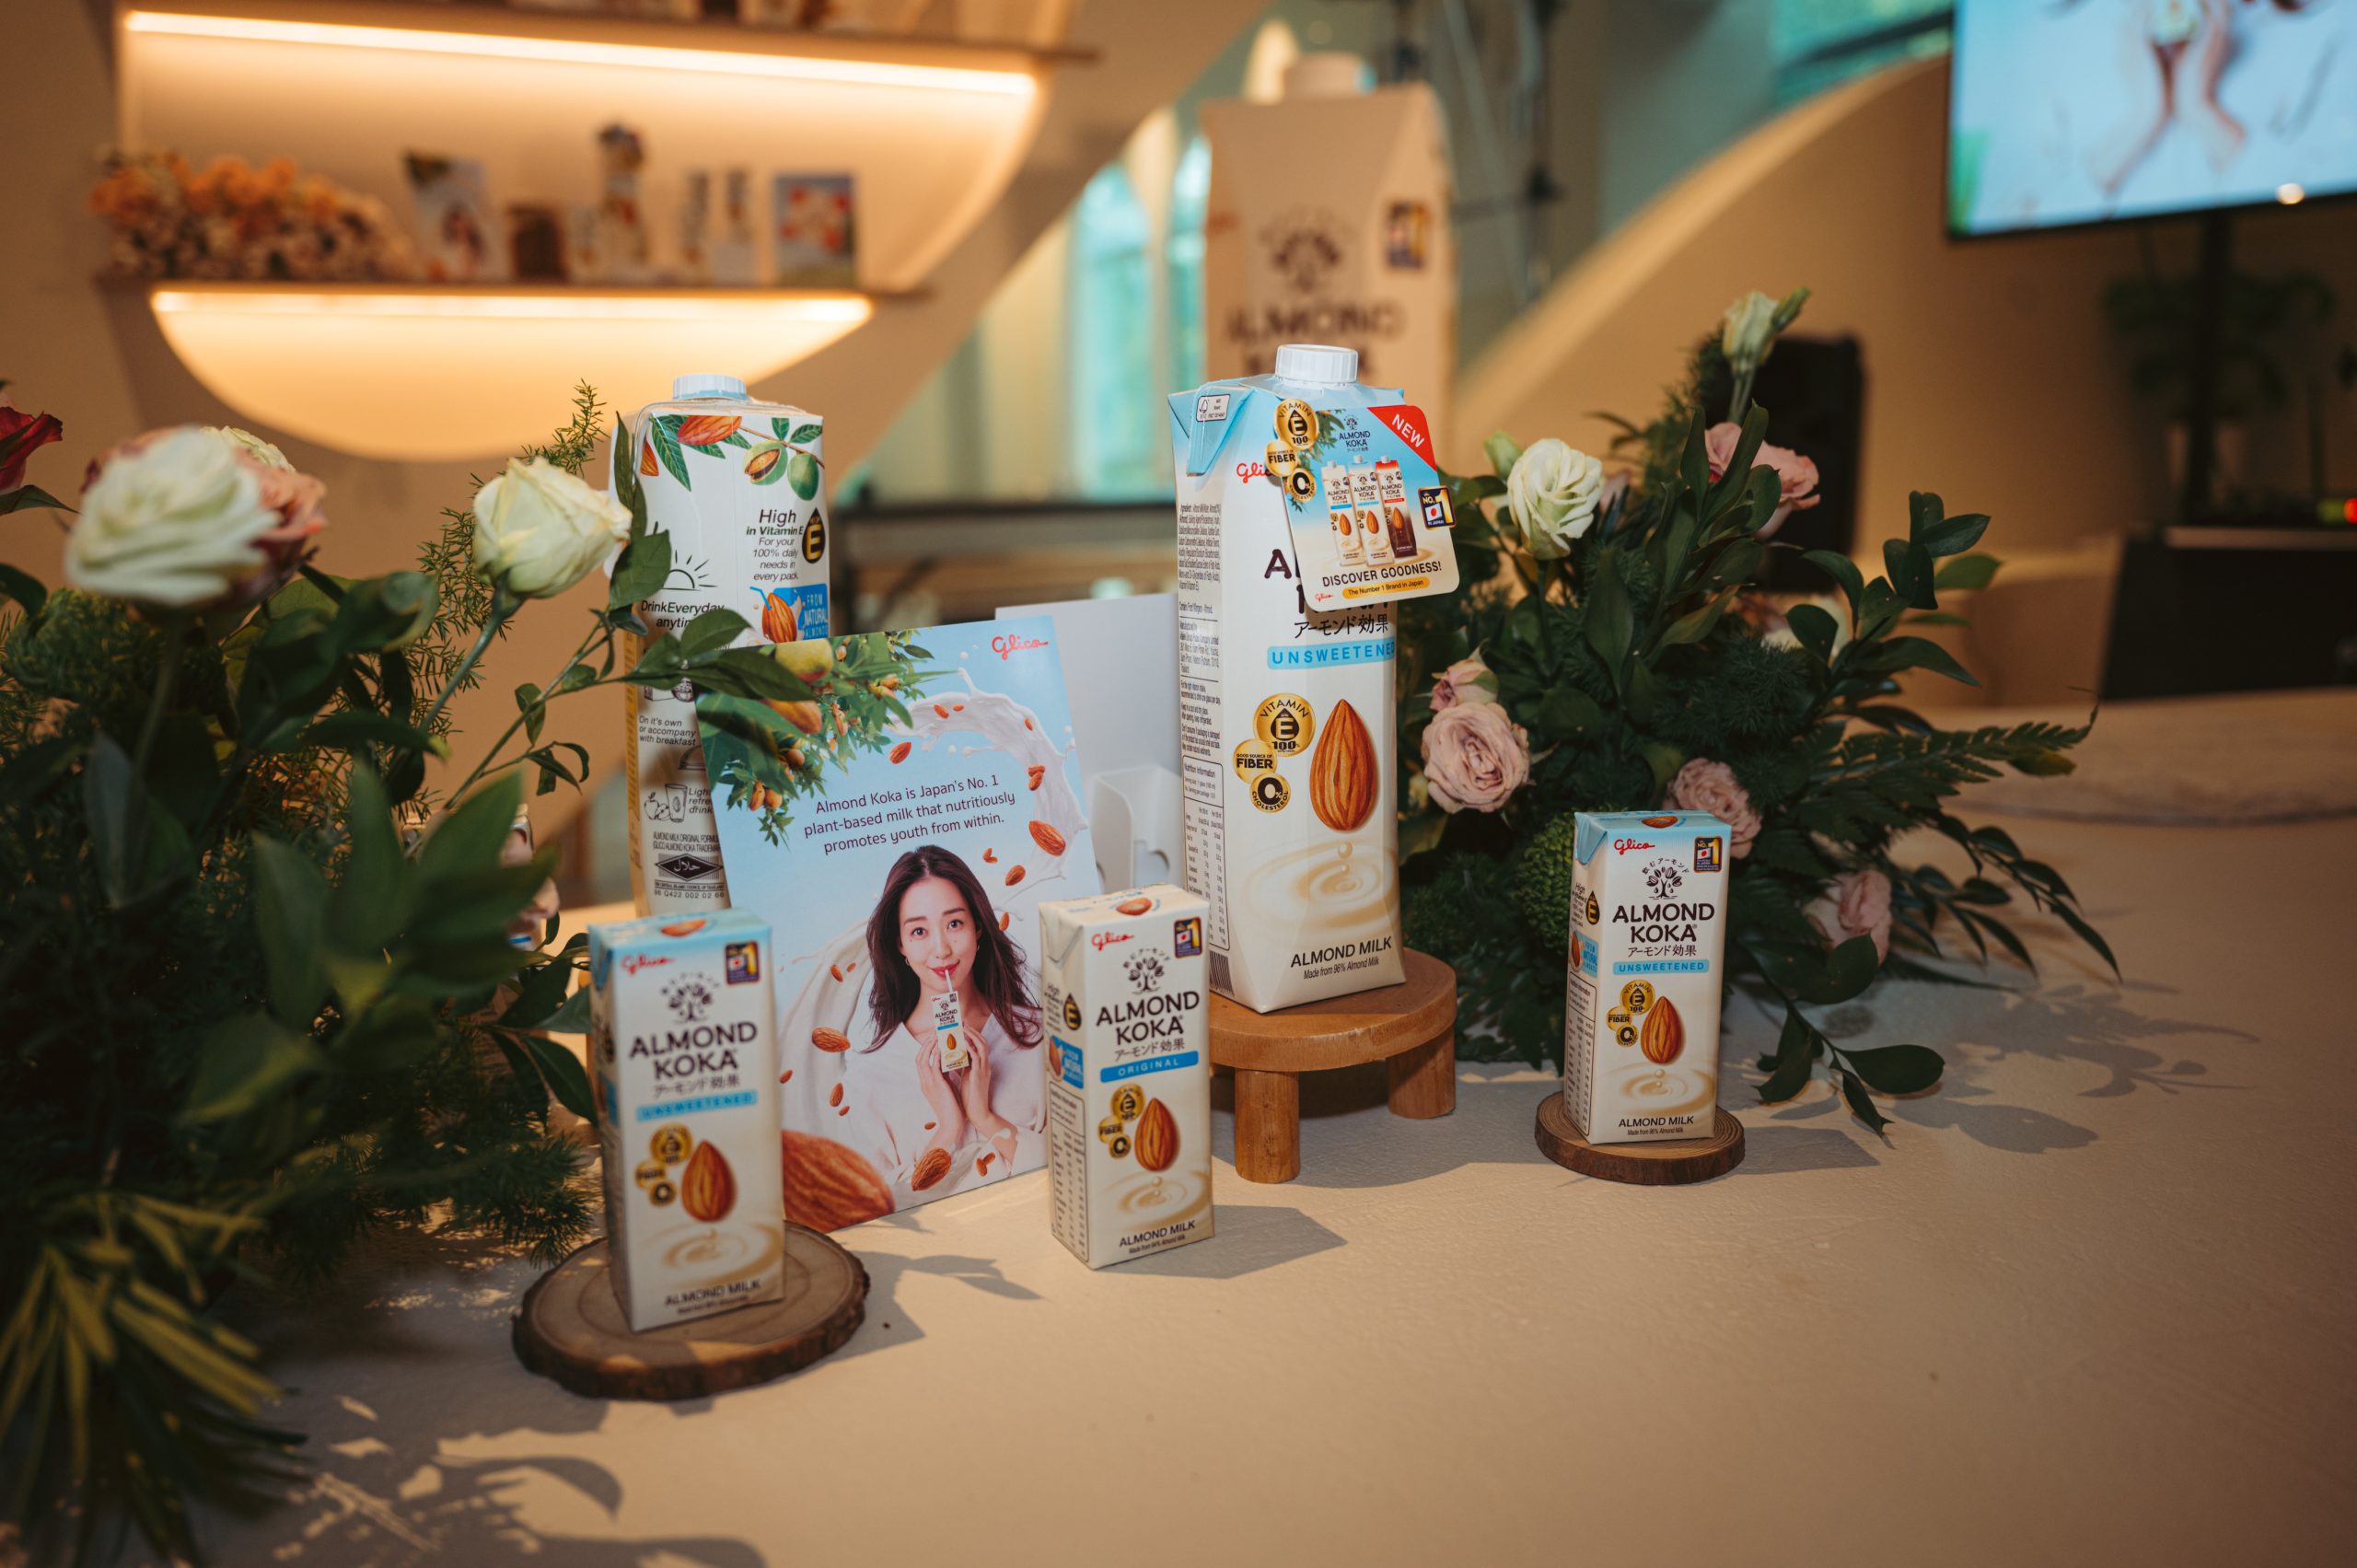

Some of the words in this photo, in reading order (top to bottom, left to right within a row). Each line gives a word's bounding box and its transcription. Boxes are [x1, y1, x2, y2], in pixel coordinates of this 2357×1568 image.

[1279, 402, 1312, 418] VITAMIN
[1339, 431, 1371, 440] ALMOND
[1391, 413, 1425, 448] NEW
[1345, 439, 1368, 447] KOKA
[1268, 454, 1295, 464] FIBER
[1422, 496, 1435, 505] NO.
[1435, 489, 1454, 524] 1
[760, 509, 796, 528] High
[746, 526, 757, 535] in
[760, 526, 798, 535] Vitamin
[798, 526, 805, 535] E
[759, 537, 774, 546] For
[776, 539, 795, 548] your
[807, 524, 822, 561] E
[753, 549, 780, 558] 100%
[782, 549, 799, 559] daily
[760, 561, 788, 569] needs
[1322, 570, 1378, 587] DISCOVER
[1381, 561, 1442, 578] GOODNESS!
[753, 574, 779, 583] every
[1359, 586, 1380, 595] Number
[1386, 582, 1401, 590] Brand
[1408, 579, 1424, 588] Japan
[807, 593, 823, 606] FROM
[804, 608, 828, 626] NATURAL
[1294, 613, 1389, 639] アーモンド効果
[1271, 641, 1396, 665] UNSWEETENED
[1260, 699, 1309, 718] VITAMIN
[639, 715, 649, 724] On
[650, 717, 662, 726] it's
[664, 718, 682, 726] own
[1275, 716, 1295, 738] E
[647, 728, 697, 738] accompany
[656, 738, 696, 746] breakfast
[1236, 758, 1273, 769] FIBER
[816, 796, 867, 814] Almond
[870, 790, 902, 806] Koka
[905, 788, 916, 800] is
[920, 780, 964, 799] Japan's
[967, 776, 987, 790] No.
[992, 774, 999, 786] 1
[1252, 790, 1289, 810] CHOLESTEROL
[804, 811, 883, 839] plant-based
[886, 808, 913, 823] milk
[916, 803, 943, 818] that
[946, 792, 1016, 812] nutritiously
[824, 834, 887, 855] promotes
[890, 825, 929, 844] youth
[932, 820, 961, 834] from
[963, 813, 1004, 829] within.
[1614, 839, 1655, 855] Glico
[1612, 902, 1715, 923] ALMOND
[1290, 944, 1355, 968] ALMOND
[1359, 935, 1392, 956] MILK
[1628, 945, 1697, 958] アーモンド効果
[1304, 970, 1319, 980] Made
[1319, 966, 1333, 976] from
[1333, 962, 1345, 974] 96%
[1347, 959, 1368, 971] Almond
[1368, 957, 1379, 967] Milk
[1619, 962, 1704, 972] UNSWEETENED
[1624, 983, 1651, 993] VITAMIN
[935, 1009, 958, 1018] ALMOND
[1096, 991, 1200, 1027] ALMOND
[629, 1021, 758, 1059] ALMOND
[1115, 1038, 1185, 1062] アーモンド効果
[1118, 1057, 1179, 1076] ORIGINAL
[653, 1072, 741, 1098] アーモンド効果
[1619, 1117, 1666, 1128] ALMOND
[1668, 1116, 1694, 1125] MILK
[1119, 1227, 1167, 1247] ALMOND
[1170, 1220, 1196, 1235] MILK
[664, 1284, 726, 1306] ALMOND
[729, 1279, 761, 1294] MILK
